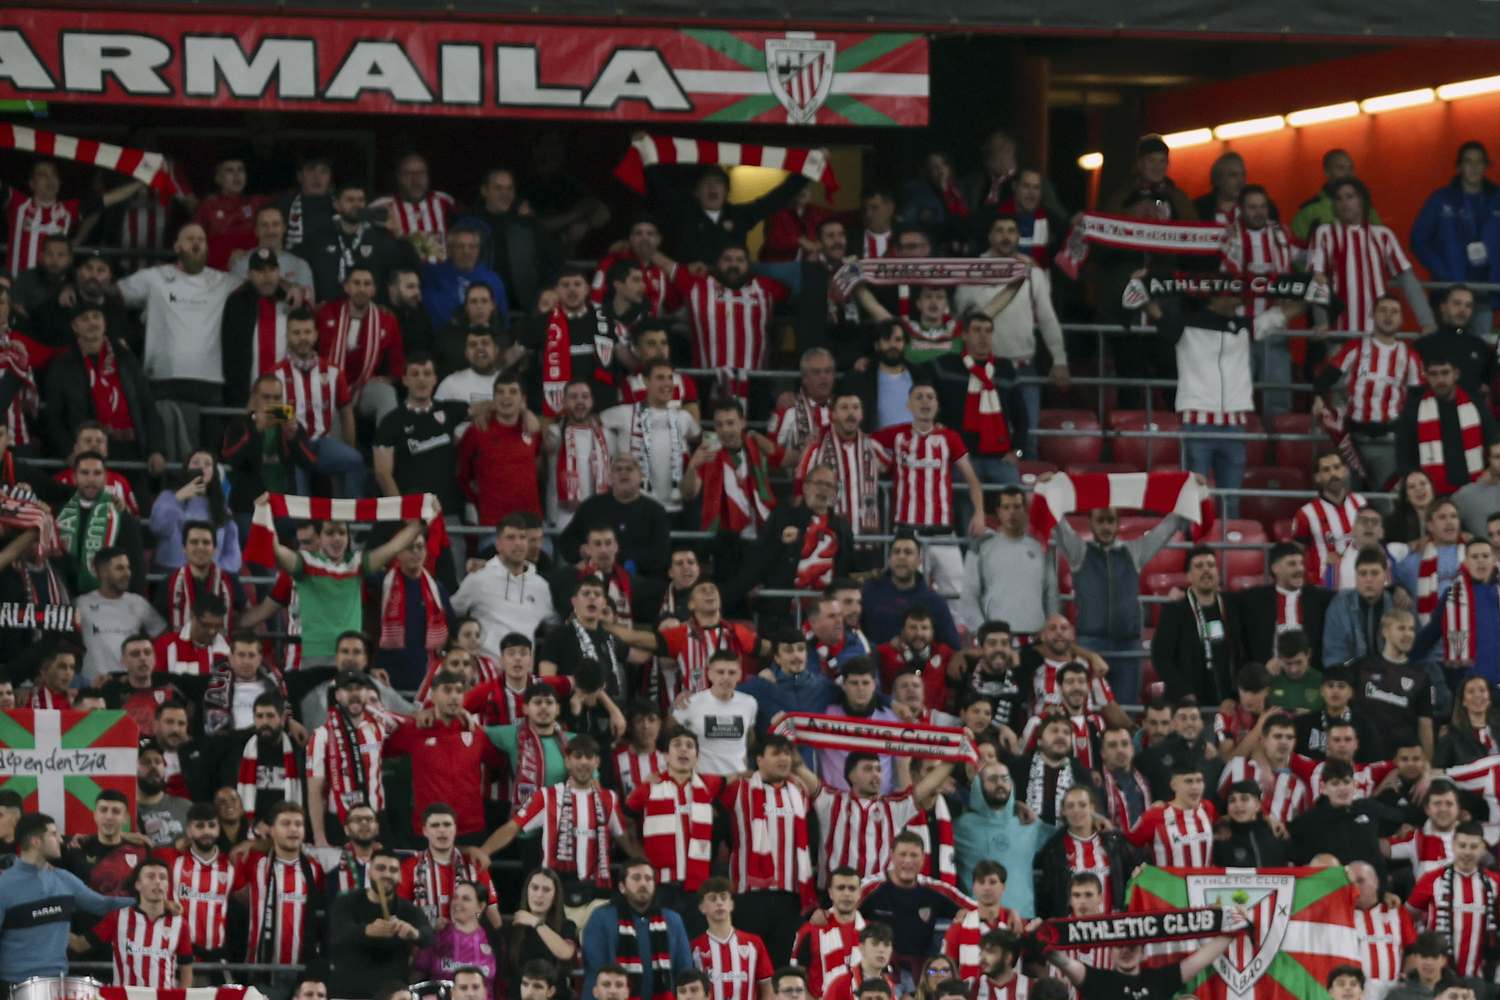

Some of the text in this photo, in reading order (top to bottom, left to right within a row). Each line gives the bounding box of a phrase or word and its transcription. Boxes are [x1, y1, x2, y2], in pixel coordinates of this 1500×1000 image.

[1150, 276, 1306, 296] ATHLETIC CLUB
[806, 716, 950, 747] ATHLETIC CLUB
[1067, 908, 1216, 943] ATHLETIC CLUB
[1219, 956, 1263, 994] BILBAO
